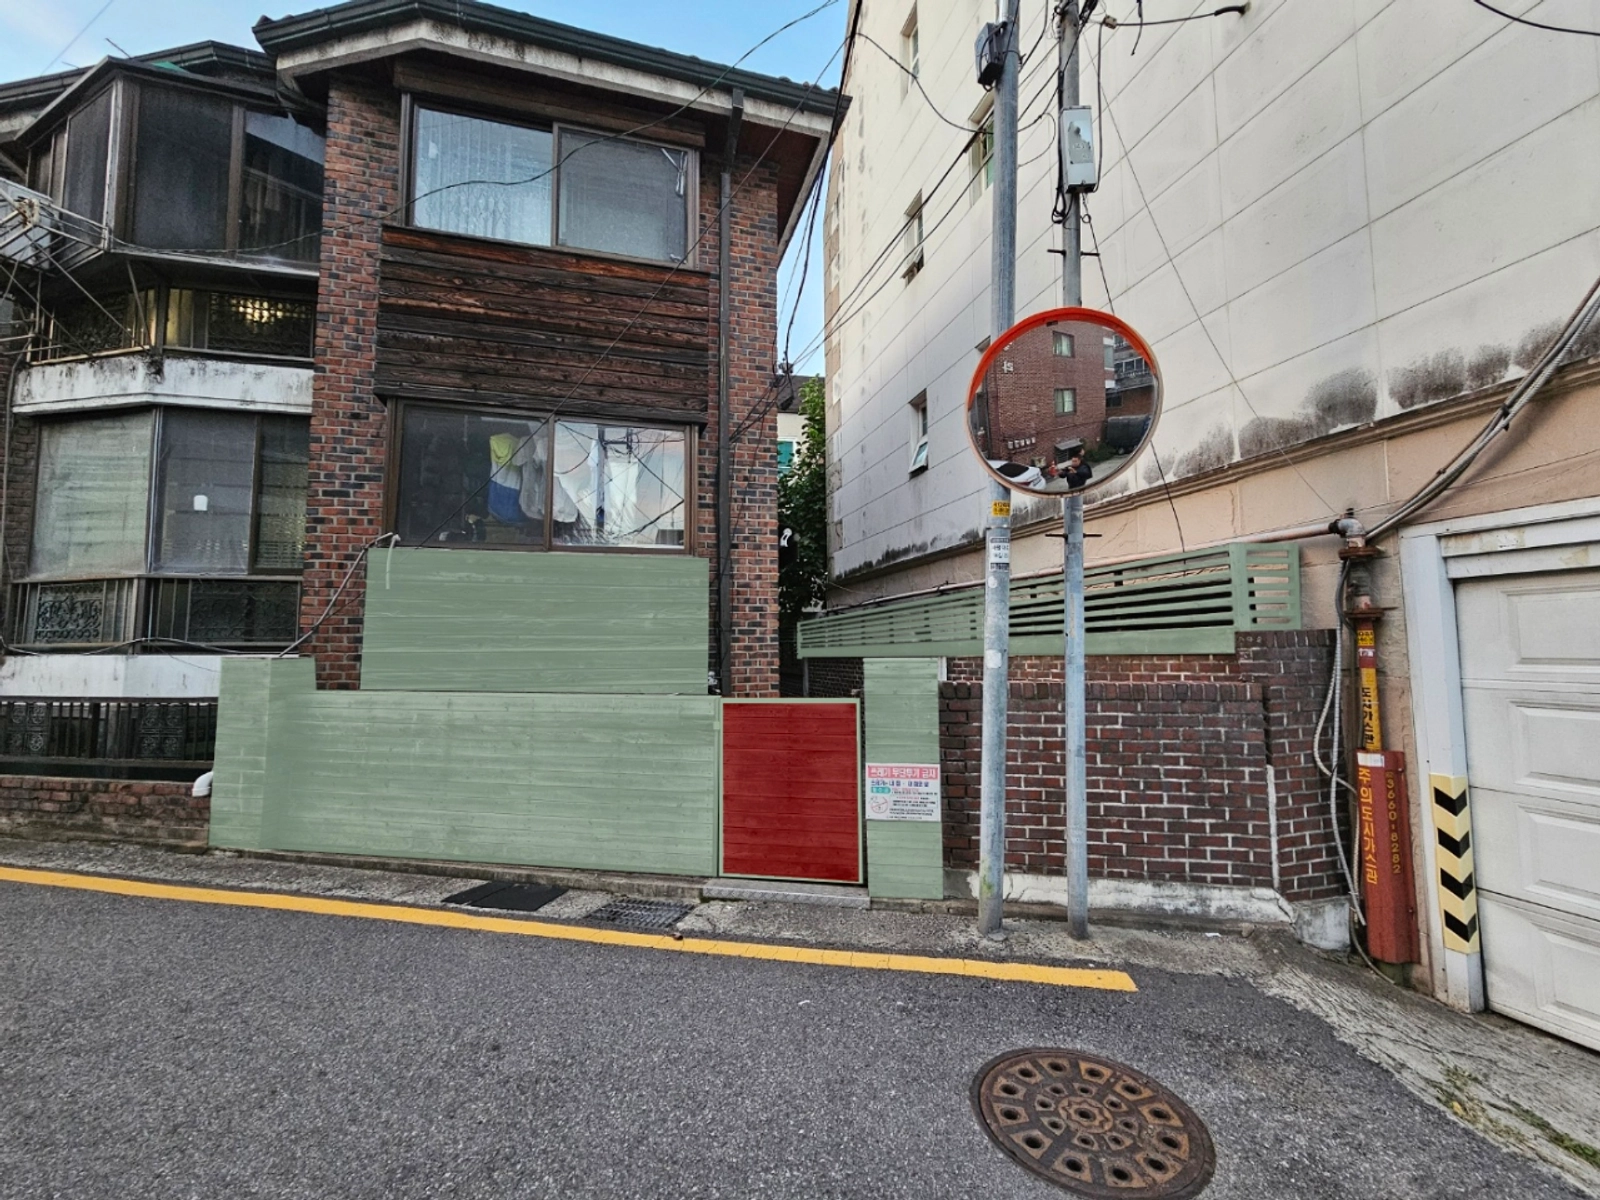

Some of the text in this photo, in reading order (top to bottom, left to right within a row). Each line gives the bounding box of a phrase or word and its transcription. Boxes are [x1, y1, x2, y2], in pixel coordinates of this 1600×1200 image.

[1362, 687, 1375, 744] 도시가스관
[871, 767, 937, 779] 쓰레기 무단투기 금지
